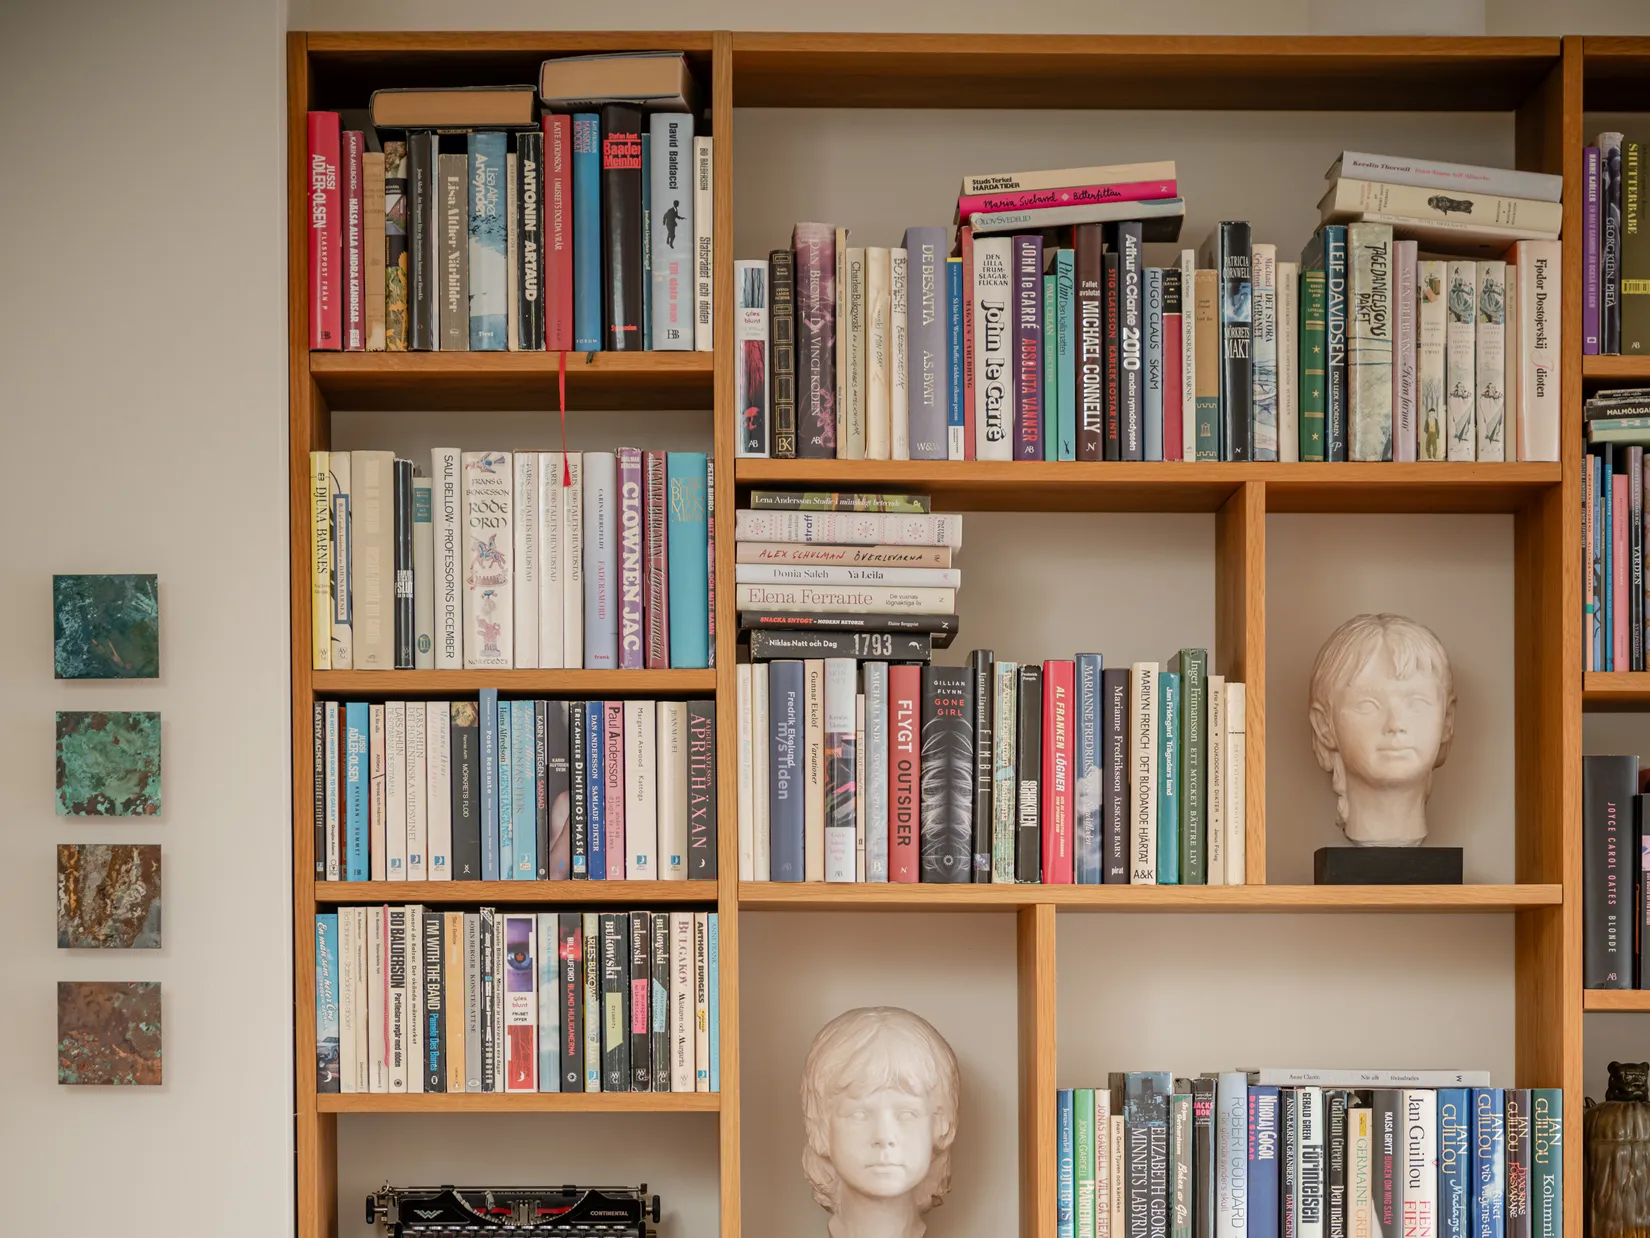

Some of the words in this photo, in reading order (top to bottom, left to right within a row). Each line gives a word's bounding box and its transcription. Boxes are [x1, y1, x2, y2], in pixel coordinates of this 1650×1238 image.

[668, 122, 678, 147] David
[326, 164, 335, 189] JUSSI
[668, 151, 678, 190] Baldacci
[1627, 143, 1637, 234] SHUTTERBABE
[312, 154, 326, 228] ADLER-OLSEN
[448, 176, 459, 204] Lisa
[524, 160, 536, 231] ANTONIN
[448, 205, 460, 247] Alther
[1606, 217, 1615, 252] GEORG
[525, 240, 536, 301] ARTAUD
[922, 244, 933, 263] DE
[1022, 242, 1035, 272] JOHN
[1330, 242, 1343, 272] LEIF
[1607, 254, 1615, 278] KLEIN
[448, 250, 460, 312] Närbilder
[1022, 277, 1035, 288] le
[1150, 271, 1159, 309] HUGO
[1535, 259, 1547, 290] Fjodor
[922, 265, 934, 325] BESATTA
[1022, 291, 1039, 329] CARRÉ
[1606, 284, 1616, 307] PIETÀ
[1082, 301, 1099, 361] MICHAEL
[1150, 312, 1159, 349] CLAUS
[1330, 279, 1344, 366] DAVIDSEN
[1535, 293, 1547, 349] Dostojevskij
[923, 351, 933, 371] A.S.
[1022, 338, 1037, 393] ABSOLUTA
[1123, 327, 1139, 370] 2010
[924, 373, 934, 406] BYATT
[1150, 359, 1159, 389] SKAM
[1083, 364, 1100, 433] CONNELLY
[1022, 397, 1038, 441] VÄNNER
[444, 455, 453, 480] SAUL
[445, 483, 453, 523] BELLOW
[622, 482, 639, 602] CLOWNEN
[759, 550, 787, 558] ALEX
[792, 550, 846, 559] SCHULMAN
[854, 551, 922, 562] ÖVERLEVARNA
[445, 529, 453, 602] PROFESSORNS
[748, 588, 795, 603] Elena
[801, 590, 873, 604] Ferrante
[445, 605, 454, 658] DECEMBER
[622, 607, 639, 651] JAC
[853, 633, 892, 656] 1793
[935, 698, 964, 706] GONE
[1140, 670, 1150, 711] MARILYN
[608, 707, 620, 728] Paul
[898, 700, 912, 752] FLYGT
[1140, 713, 1150, 749] FRENCH
[609, 732, 620, 788] Andersson
[1140, 756, 1149, 773] DET
[691, 713, 708, 848] APRILHÄXAN
[898, 760, 911, 846] OUTSIDER
[1139, 776, 1151, 825] BLÖDANDE
[1608, 802, 1616, 832] JOYCE
[1139, 827, 1150, 864] HJÄRTAT
[1608, 838, 1616, 868] CAROL
[1608, 875, 1616, 904] OATES
[390, 912, 404, 927] BO
[427, 920, 438, 932] I'M
[1608, 916, 1617, 952] BLONDE
[391, 928, 405, 988] BALDERSON
[427, 934, 439, 962] WITH
[427, 964, 439, 981] THE
[428, 983, 440, 1009] BAND
[1408, 1096, 1424, 1122] Jan
[1535, 1098, 1548, 1163] GUILLOU
[1549, 1118, 1561, 1145] JAN
[1132, 1128, 1147, 1185] MINNETS
[1151, 1127, 1165, 1195] ELIZABETH
[1409, 1125, 1425, 1188] Guillou
